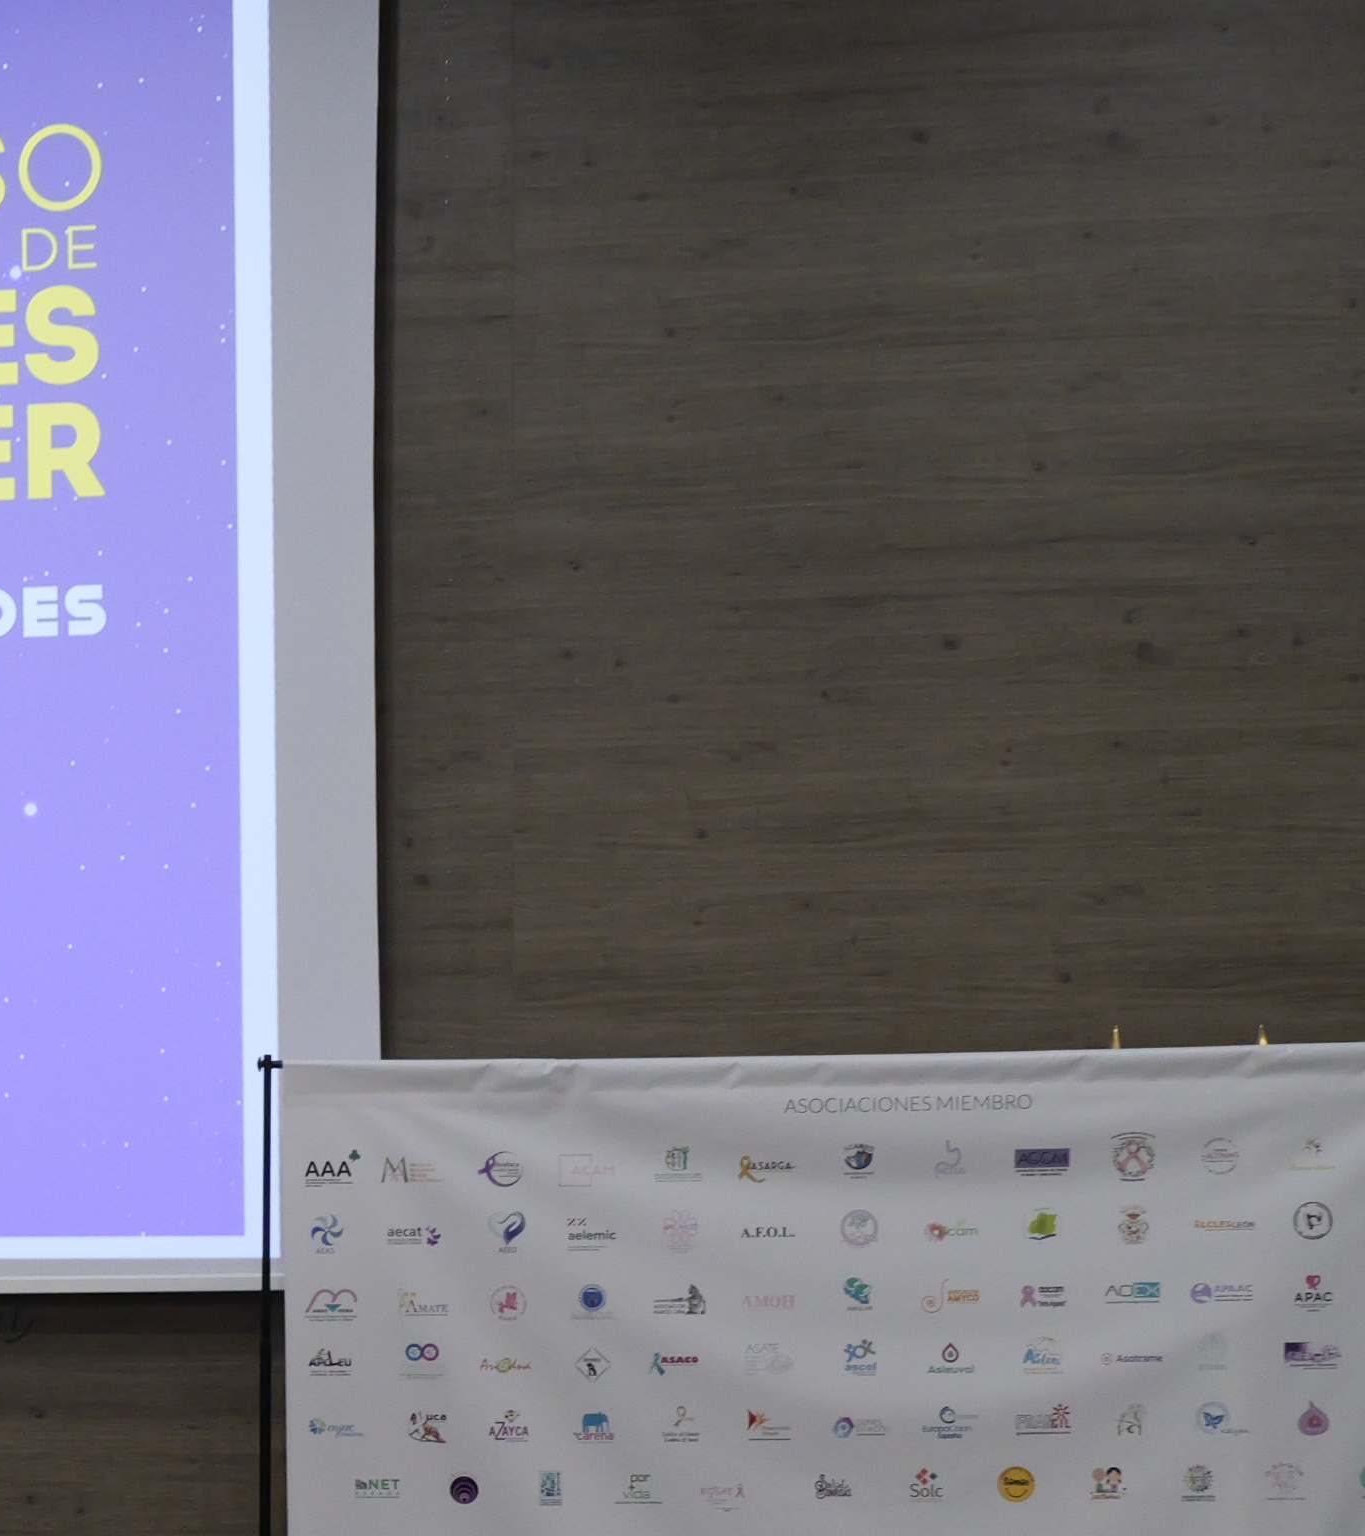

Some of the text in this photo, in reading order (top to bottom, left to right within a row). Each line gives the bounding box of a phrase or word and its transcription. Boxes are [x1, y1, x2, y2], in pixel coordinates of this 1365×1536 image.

[19, 225, 98, 271] DE
[784, 1093, 1033, 1113] ASOCIACIONES MIEMBRO
[304, 1160, 352, 1178] AAA
[387, 1227, 422, 1237] aecat
[568, 1229, 617, 1241] aelemic
[1294, 1292, 1333, 1302] APAC
[660, 1355, 699, 1364] ASACO
[488, 1421, 530, 1441] AZAYCA
[631, 1474, 651, 1484] por
[910, 1483, 943, 1498] Solc
